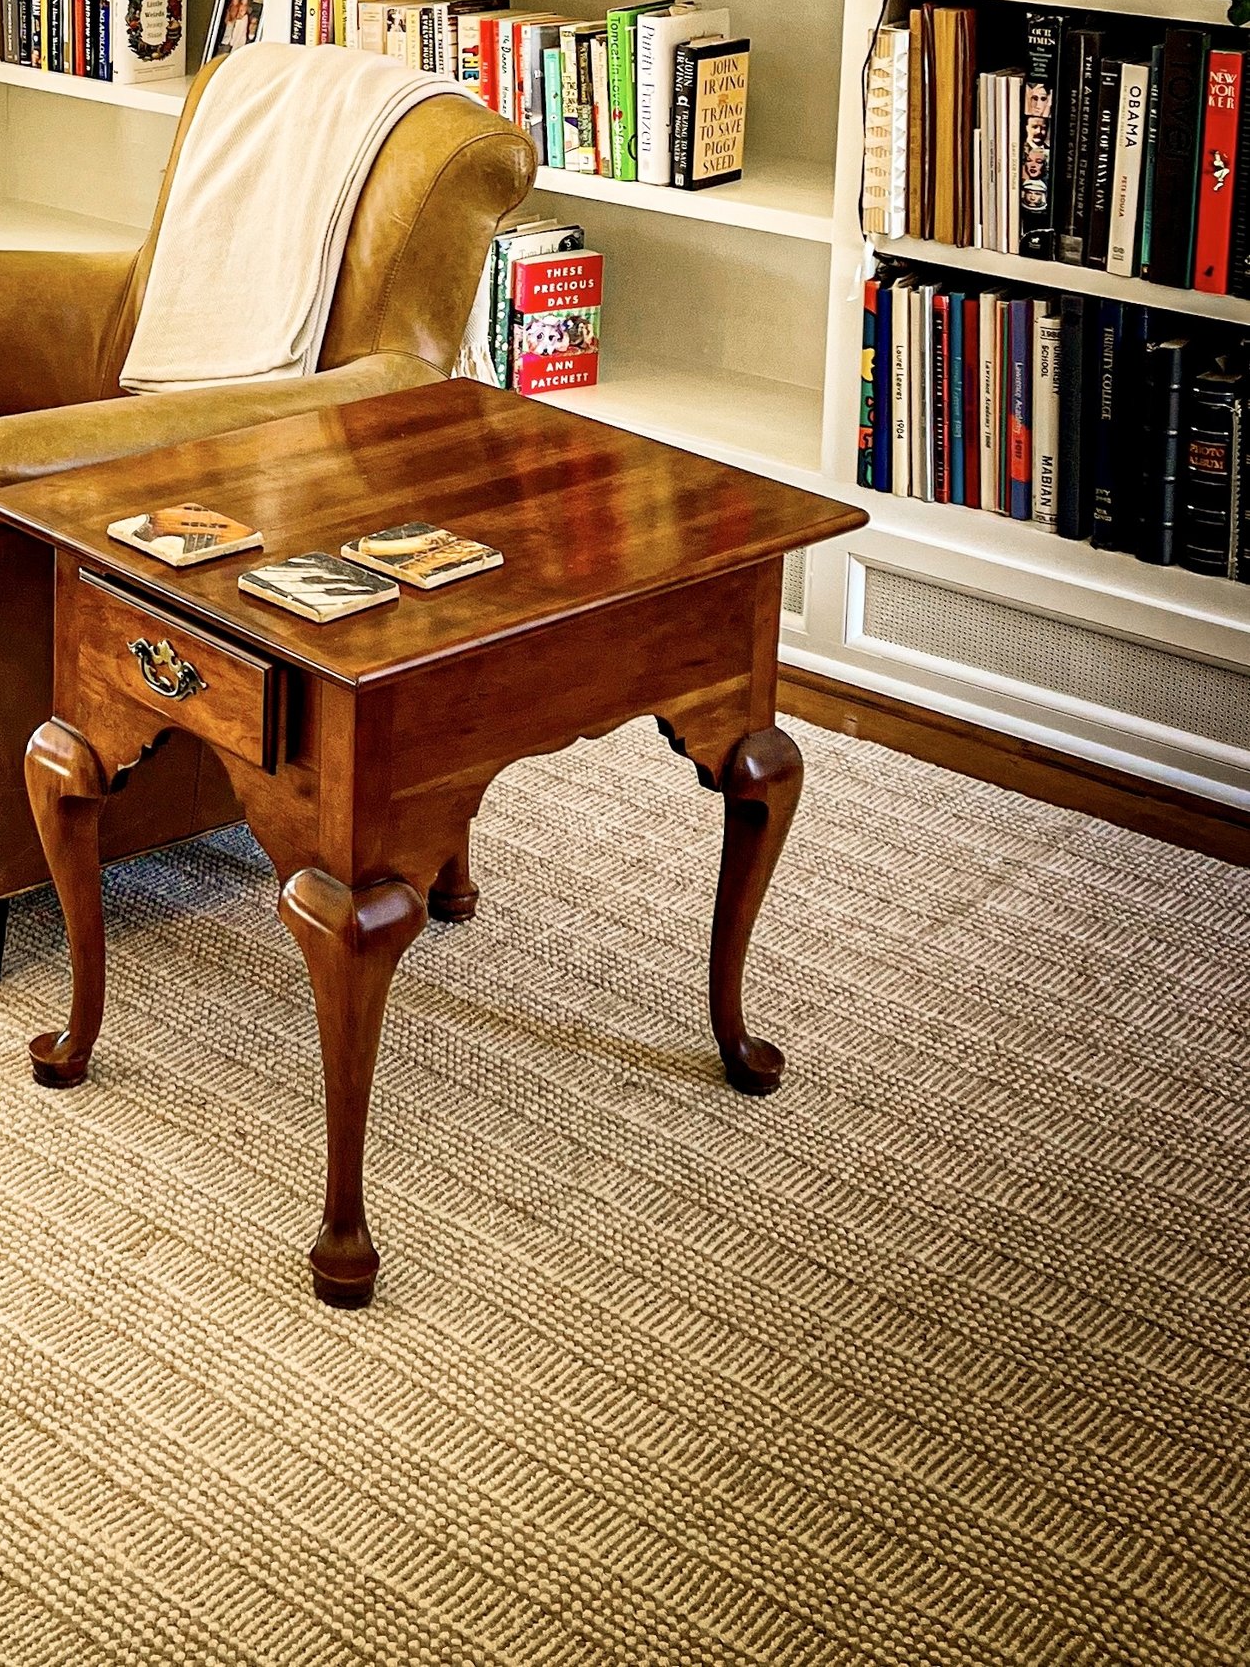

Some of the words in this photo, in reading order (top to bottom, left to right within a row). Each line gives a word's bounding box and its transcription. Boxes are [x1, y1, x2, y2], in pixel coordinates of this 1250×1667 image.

[294, 20, 303, 39] Haig
[610, 17, 621, 60] Tomcat
[463, 45, 479, 80] THE
[641, 25, 655, 76] Purity
[612, 64, 621, 74] in
[676, 51, 684, 91] IRVING
[685, 58, 694, 87] JOHN
[711, 59, 738, 76] JOHN
[1084, 55, 1092, 78] THE
[1210, 71, 1236, 83] NEW
[612, 79, 622, 106] Love
[705, 75, 744, 95] IRVING
[642, 83, 655, 151] Franzen
[702, 103, 742, 122] TRYING
[1080, 86, 1092, 152] AMERICAN
[1125, 86, 1142, 148] OBAMA
[700, 126, 711, 141] TO
[715, 119, 743, 137] SAVE
[704, 137, 737, 157] PIGGY
[702, 156, 734, 174] SNEED
[1076, 159, 1087, 217] CENTURY
[547, 266, 583, 278] THESE
[534, 279, 594, 294] PRECIOUS
[548, 295, 579, 306] DAYS
[896, 346, 904, 370] Laurel
[1041, 345, 1049, 378] SCHOOL
[1103, 327, 1114, 371] TRINITY
[546, 361, 573, 372] ANN
[1014, 362, 1023, 396] Lawrence
[531, 373, 588, 389] PATCHETT
[896, 373, 904, 400] Leaves
[1101, 374, 1113, 420] COLLEGE
[1014, 399, 1023, 434] Academy
[1041, 455, 1053, 507] MABIAN
